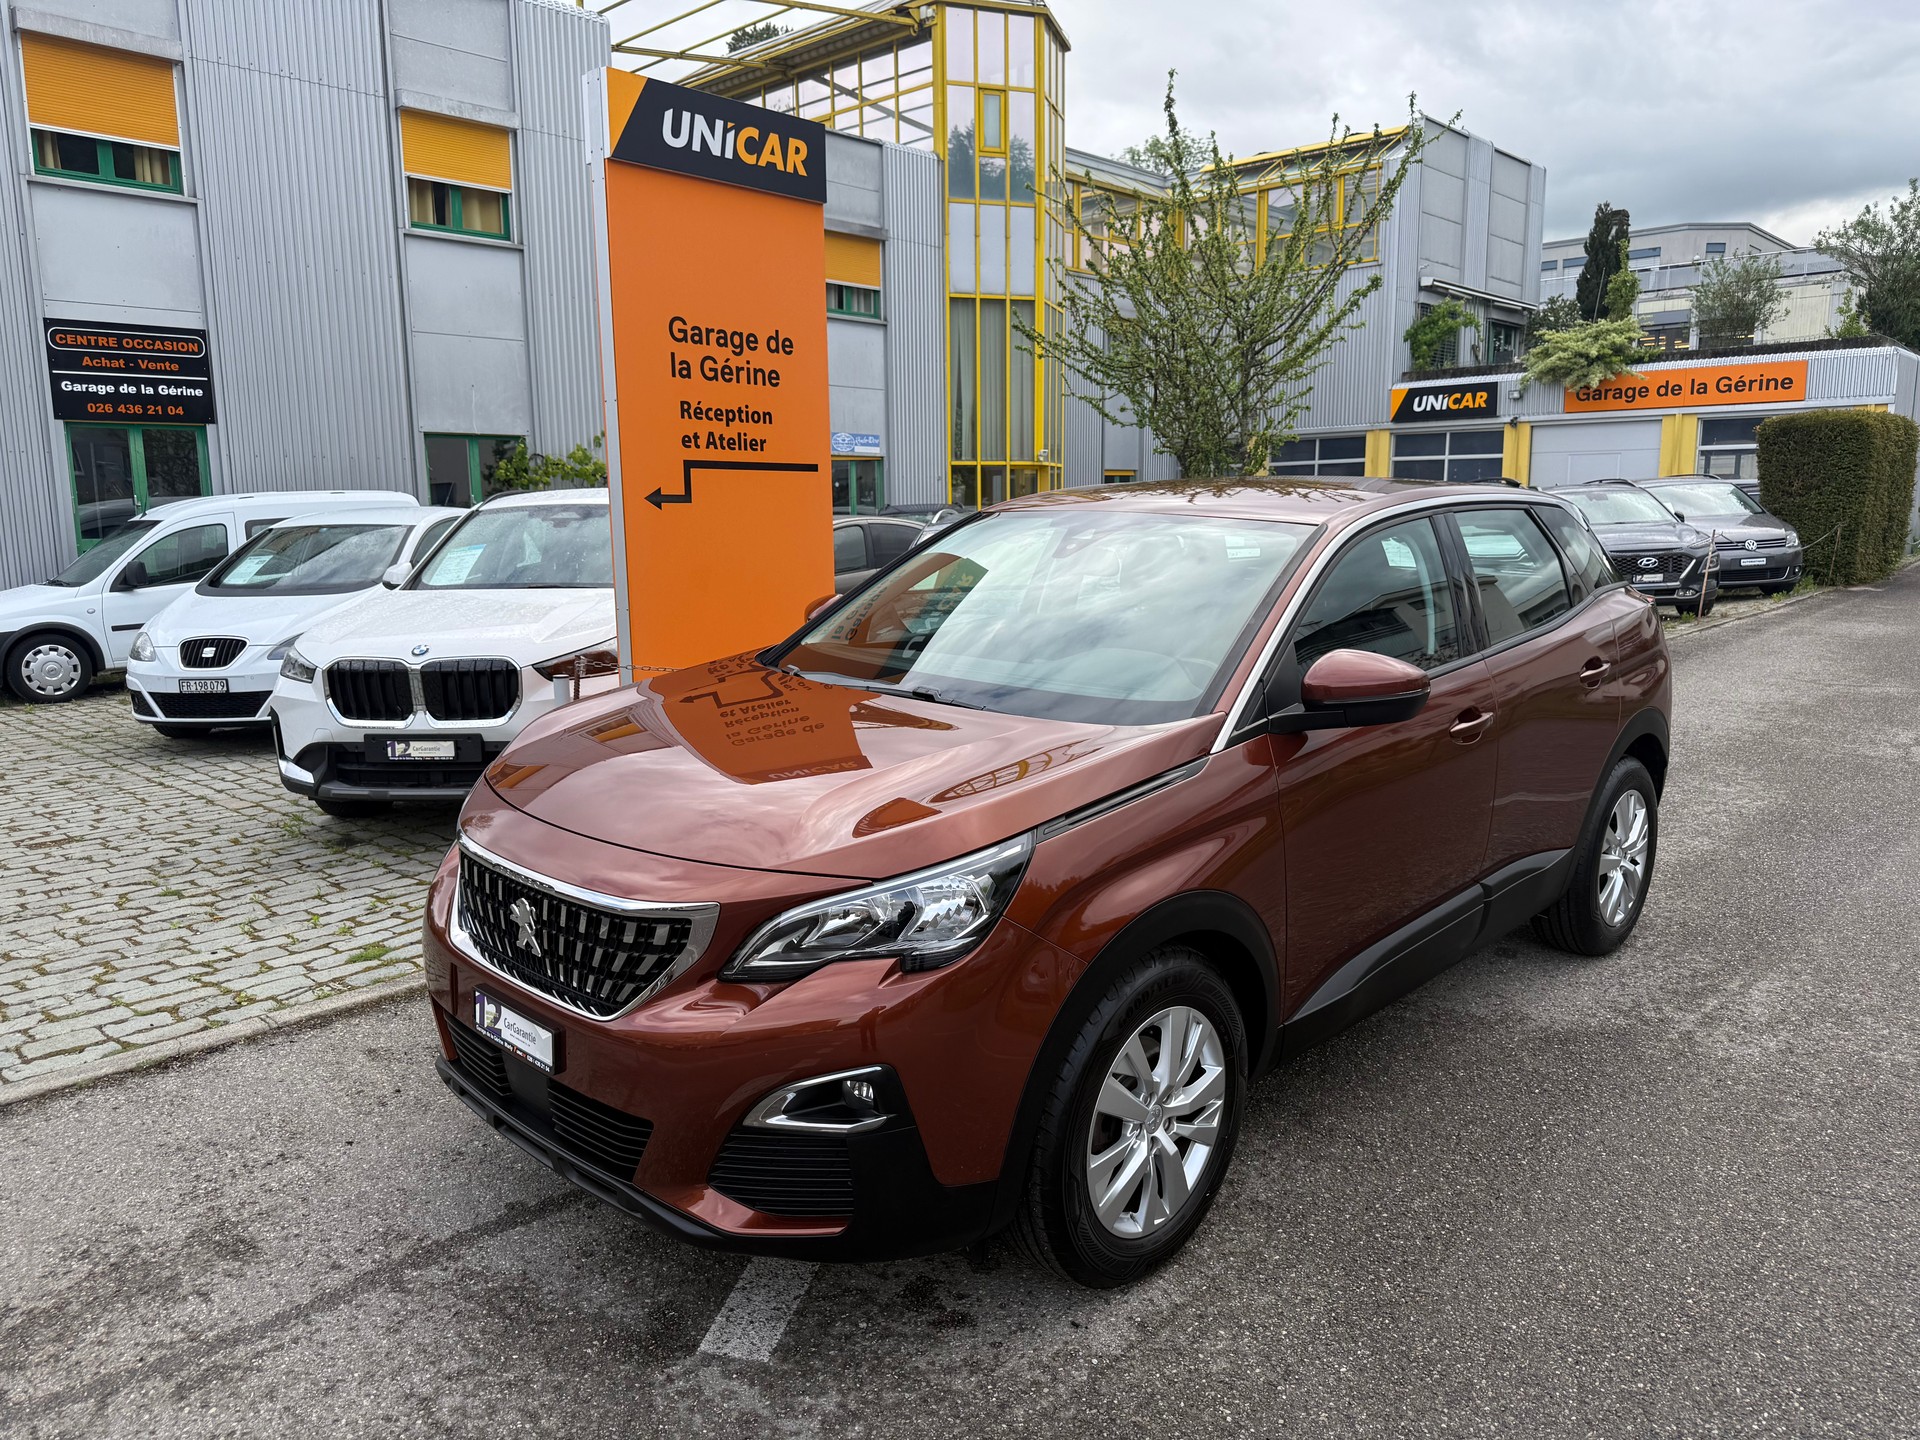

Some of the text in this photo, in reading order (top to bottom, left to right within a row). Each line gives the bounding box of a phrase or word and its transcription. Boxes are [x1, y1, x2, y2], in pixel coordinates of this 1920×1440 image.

[55, 333, 199, 353] CENTRE OCCASION
[668, 316, 795, 357] Garage de
[82, 356, 126, 368] Achat
[138, 359, 180, 371] Vente
[670, 352, 781, 388] la Gérine
[61, 381, 204, 398] Garage de la Gérine
[1575, 374, 1794, 404] Garage de la Gérine
[87, 403, 185, 416] 026 436 21 04
[680, 400, 773, 427] Réception
[681, 431, 767, 452] et Atelier
[503, 1017, 537, 1045] CarGarantie
